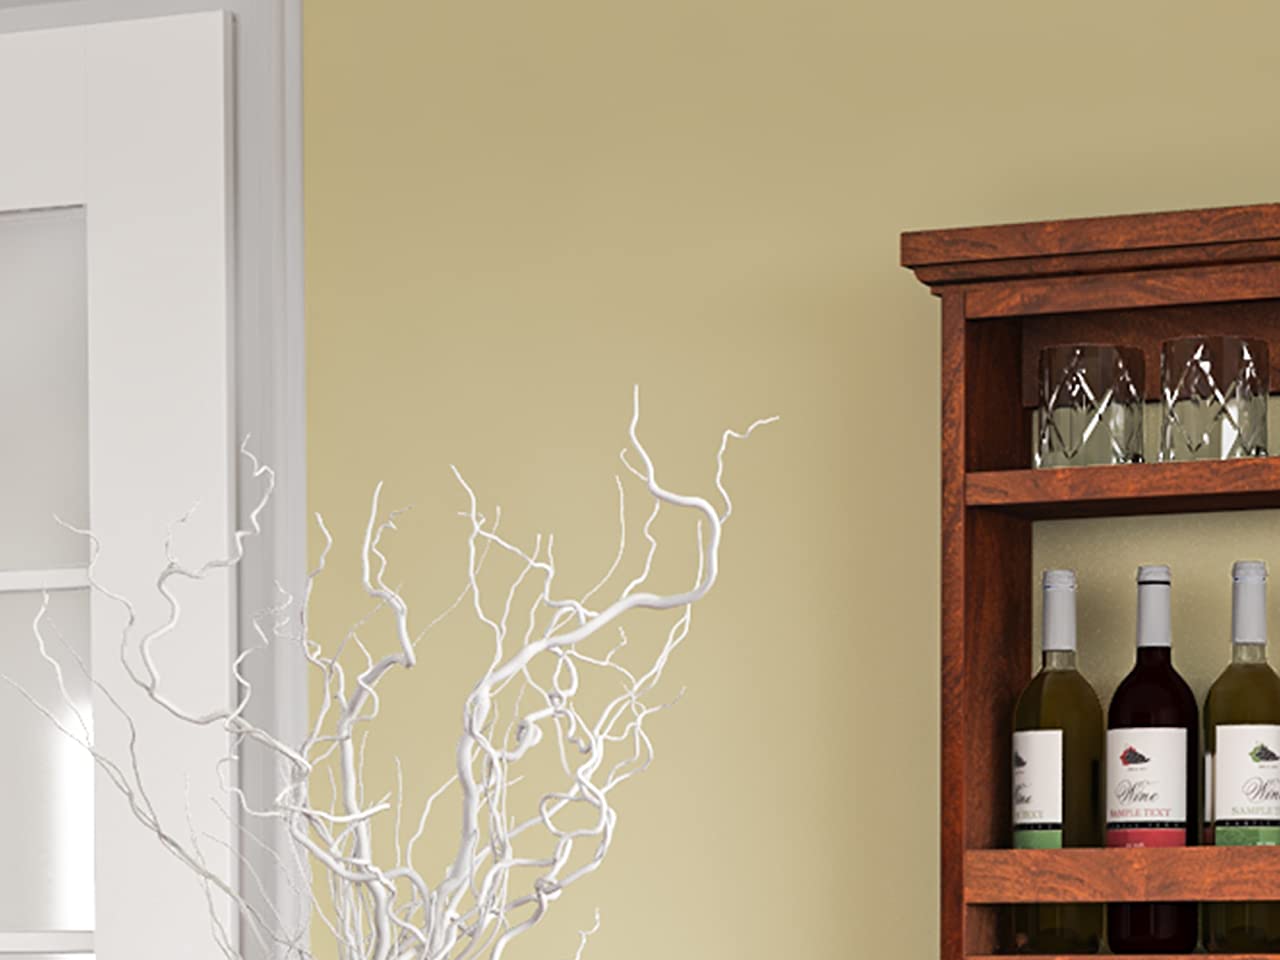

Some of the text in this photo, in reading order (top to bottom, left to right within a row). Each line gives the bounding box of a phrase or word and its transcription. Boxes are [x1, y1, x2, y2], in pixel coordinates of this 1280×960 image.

[1115, 779, 1161, 807] Wine
[1144, 808, 1172, 818] TEXT
[1231, 806, 1272, 816] SAMPLE
